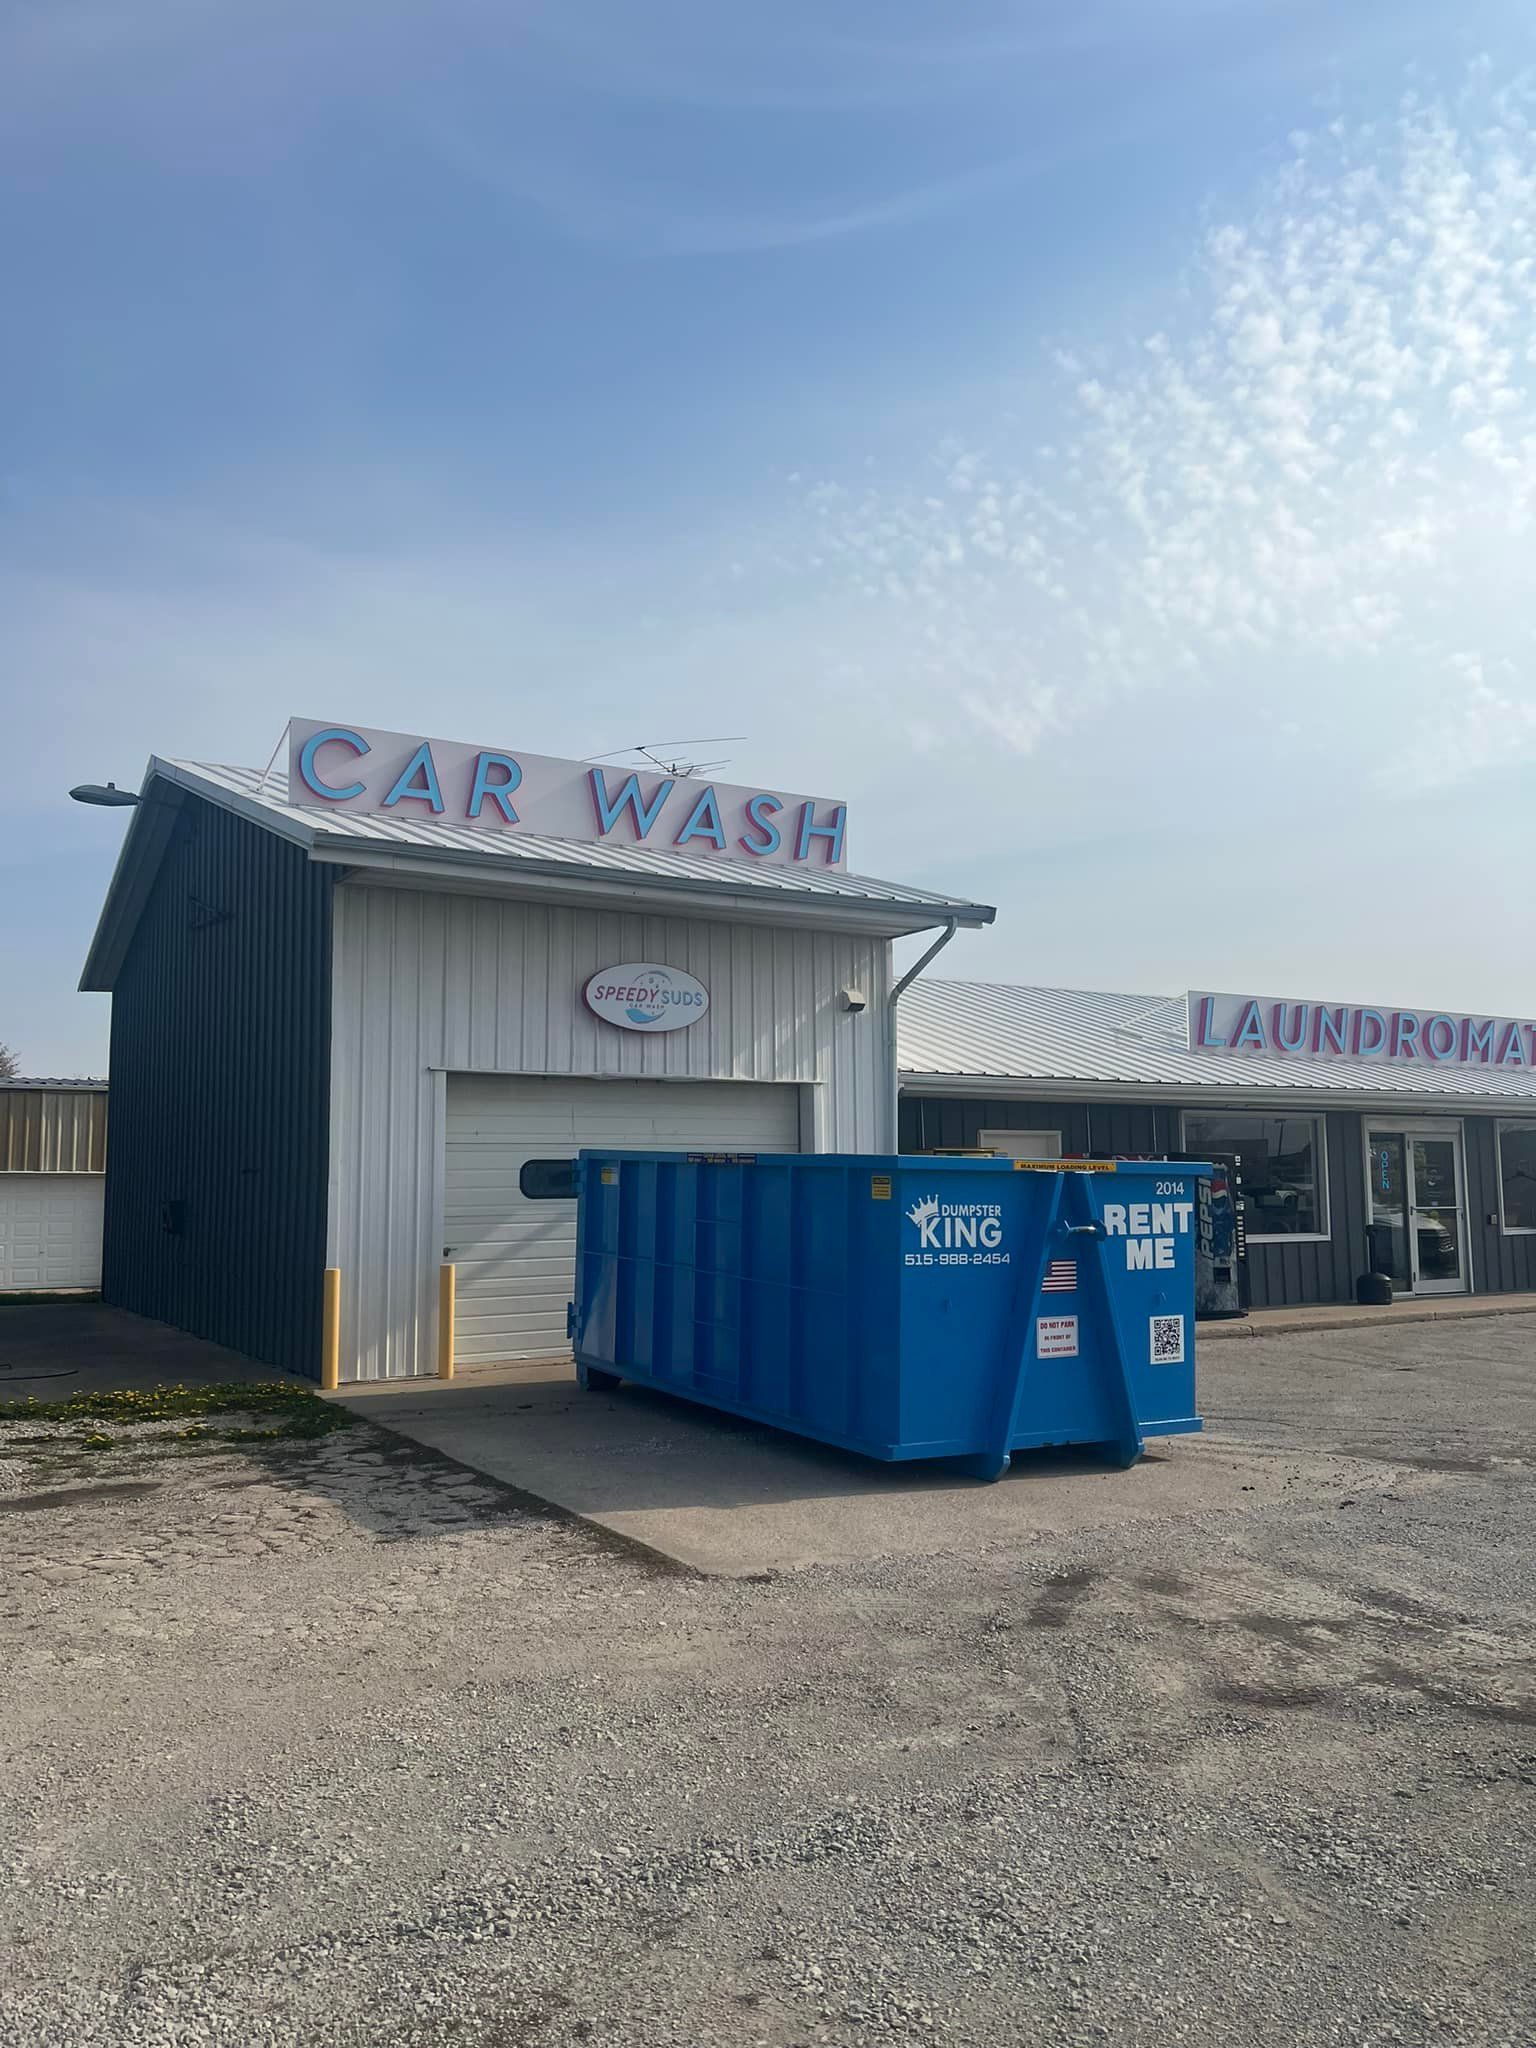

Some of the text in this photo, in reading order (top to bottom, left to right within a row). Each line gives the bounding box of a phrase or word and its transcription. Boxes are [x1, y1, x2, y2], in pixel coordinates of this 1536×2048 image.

[299, 728, 848, 864] CAR WASH
[594, 985, 703, 1007] SPEEDY SUDS
[1381, 1151, 1390, 1190] OPEN
[1156, 1182, 1184, 1195] 2014
[941, 1205, 1002, 1217] DUMPSTER
[1103, 1203, 1193, 1236] RENT
[1198, 1177, 1215, 1260] PEPSI
[919, 1217, 1002, 1248] KING
[904, 1253, 1011, 1266] 515-988-2454
[1126, 1238, 1175, 1271] ME
[1040, 1320, 1075, 1330] DO NOT PARK
